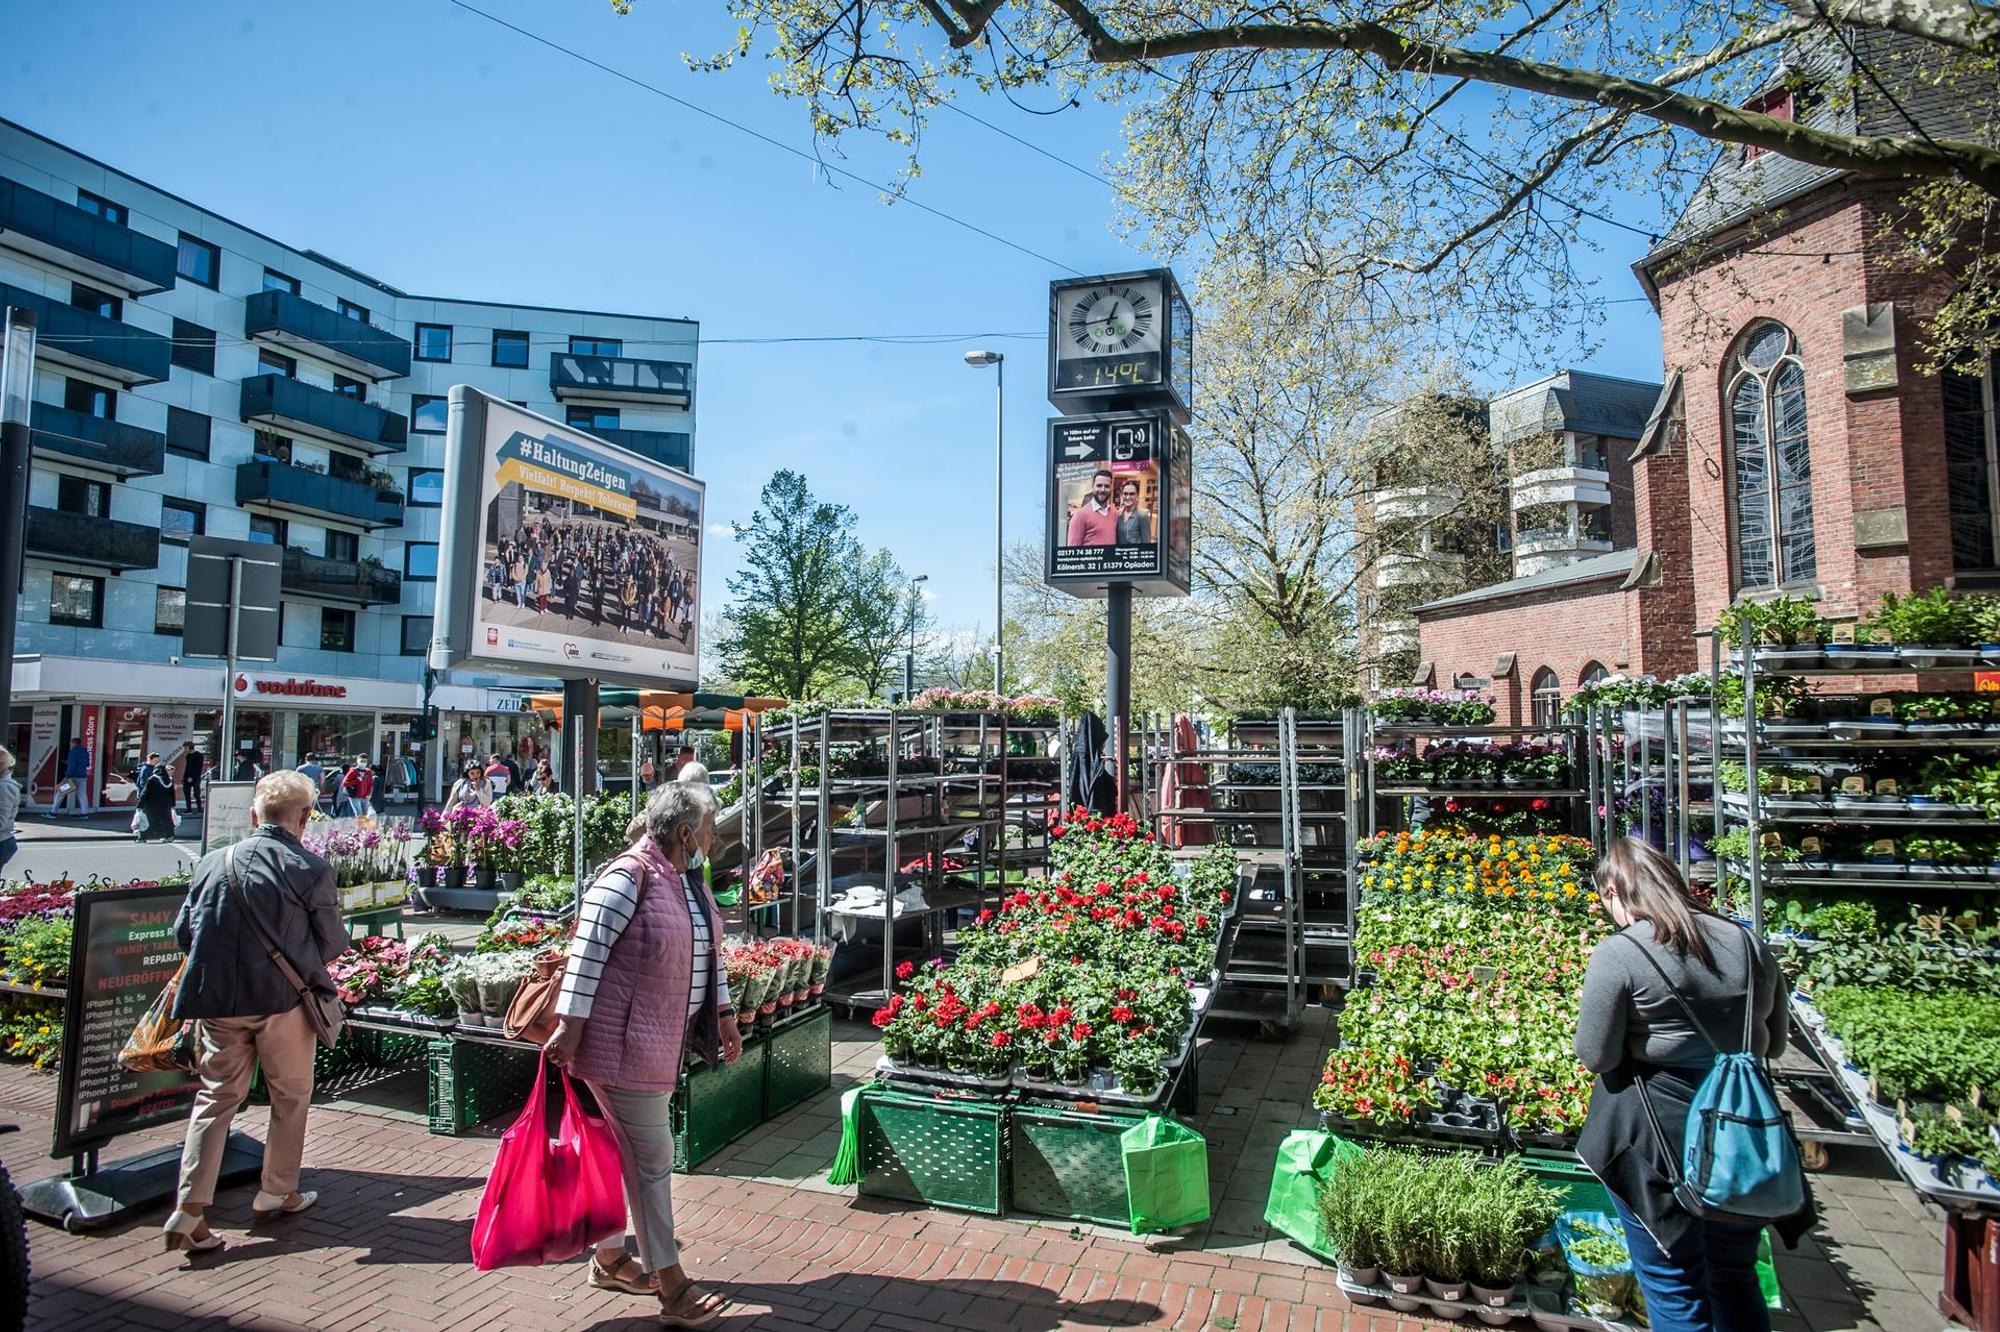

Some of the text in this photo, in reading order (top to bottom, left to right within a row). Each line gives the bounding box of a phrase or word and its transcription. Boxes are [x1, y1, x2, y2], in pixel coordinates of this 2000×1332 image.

[520, 438, 626, 491] #HaltungZeigen
[519, 465, 557, 488] Vielfalt!
[560, 480, 594, 501] Respekt!
[1087, 562, 1097, 570] 32
[1103, 561, 1123, 570] 51379
[1124, 560, 1156, 570] Opladen
[256, 678, 347, 698] vodafone
[152, 711, 189, 719] vodafone
[130, 911, 170, 927] SAMY
[128, 929, 166, 942] Express
[110, 1074, 121, 1083] XS
[109, 1084, 119, 1094] XS
